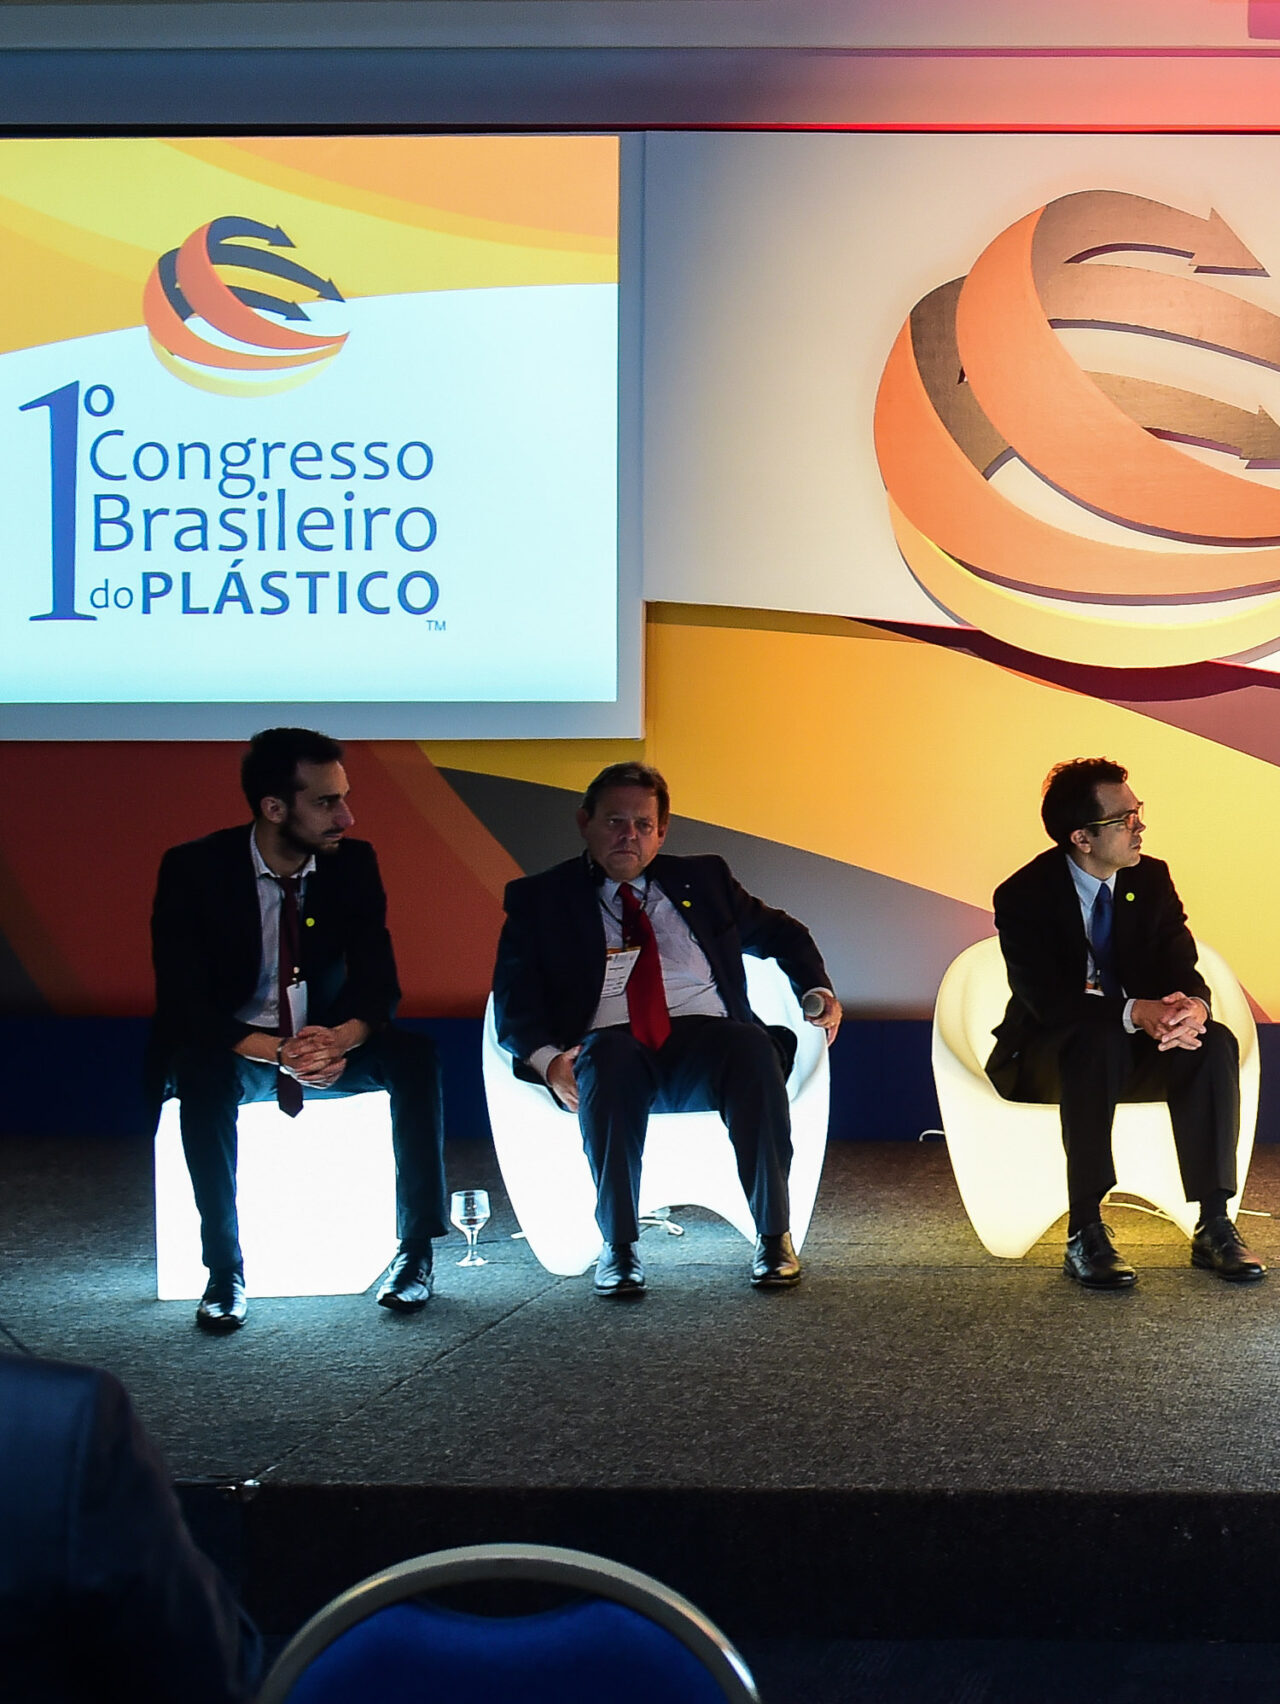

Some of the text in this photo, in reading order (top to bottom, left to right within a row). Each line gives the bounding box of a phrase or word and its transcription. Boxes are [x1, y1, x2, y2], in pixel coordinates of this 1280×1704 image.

[89, 429, 434, 500] Congresso
[92, 488, 437, 552] Brasileiro
[89, 559, 440, 616] do PLÁSTICO
[425, 620, 447, 631] TM
